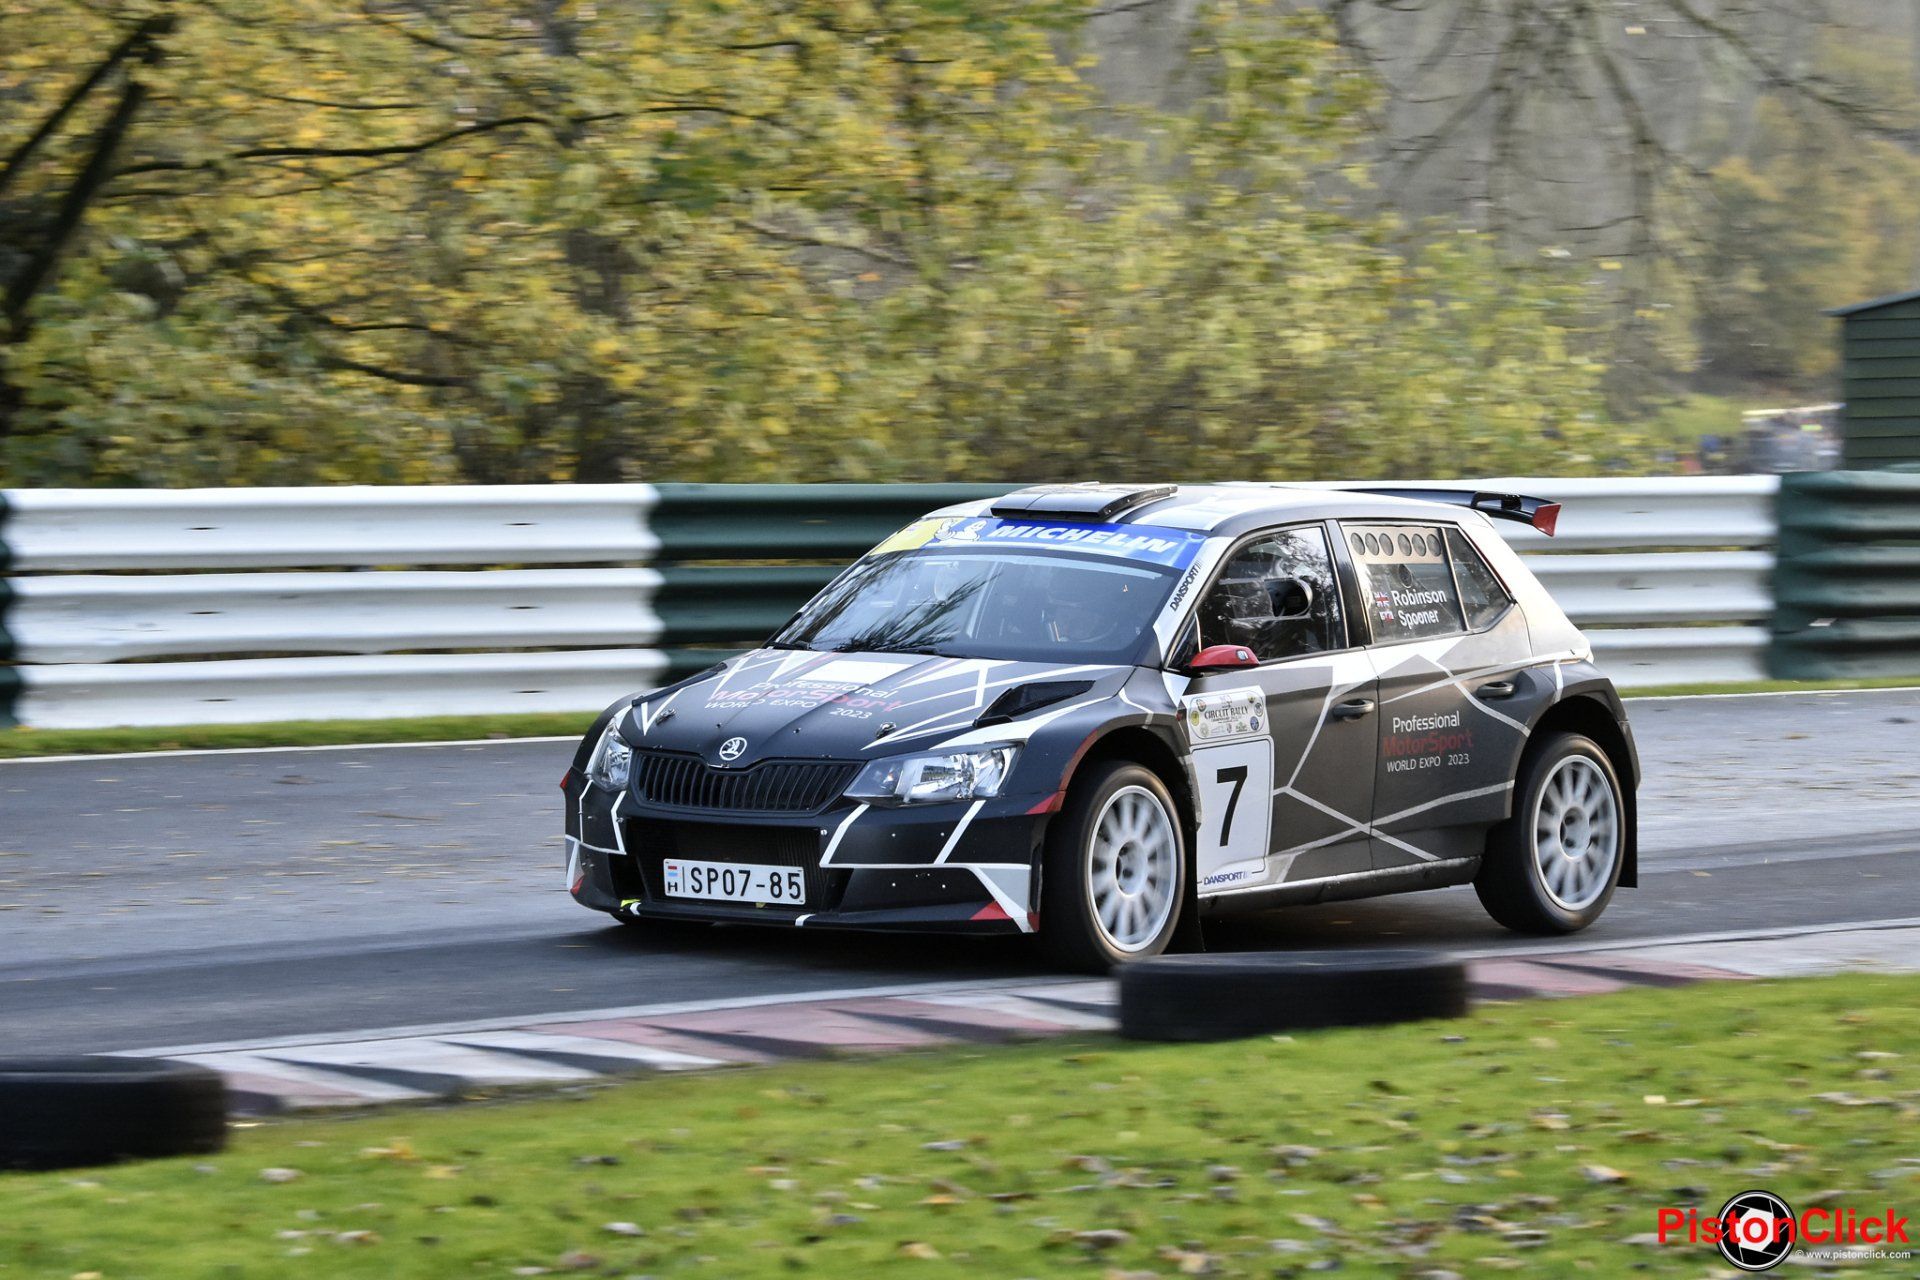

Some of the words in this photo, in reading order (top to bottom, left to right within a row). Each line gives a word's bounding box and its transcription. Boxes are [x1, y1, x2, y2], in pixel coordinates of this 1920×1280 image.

[988, 525, 1178, 552] MICHELIN
[1170, 565, 1199, 612] DANSPORT
[1391, 589, 1447, 607] Robinson
[1398, 609, 1440, 629] Spooner
[769, 699, 817, 708] EXPO
[829, 707, 873, 719] 2023
[1393, 711, 1460, 733] Professional
[1383, 729, 1474, 757] MotorSport
[1386, 758, 1417, 773] WORLD
[1419, 756, 1441, 769] EXPO
[1447, 753, 1470, 766] 2023
[1216, 765, 1248, 847] 7
[1203, 872, 1243, 885] DANSPORT
